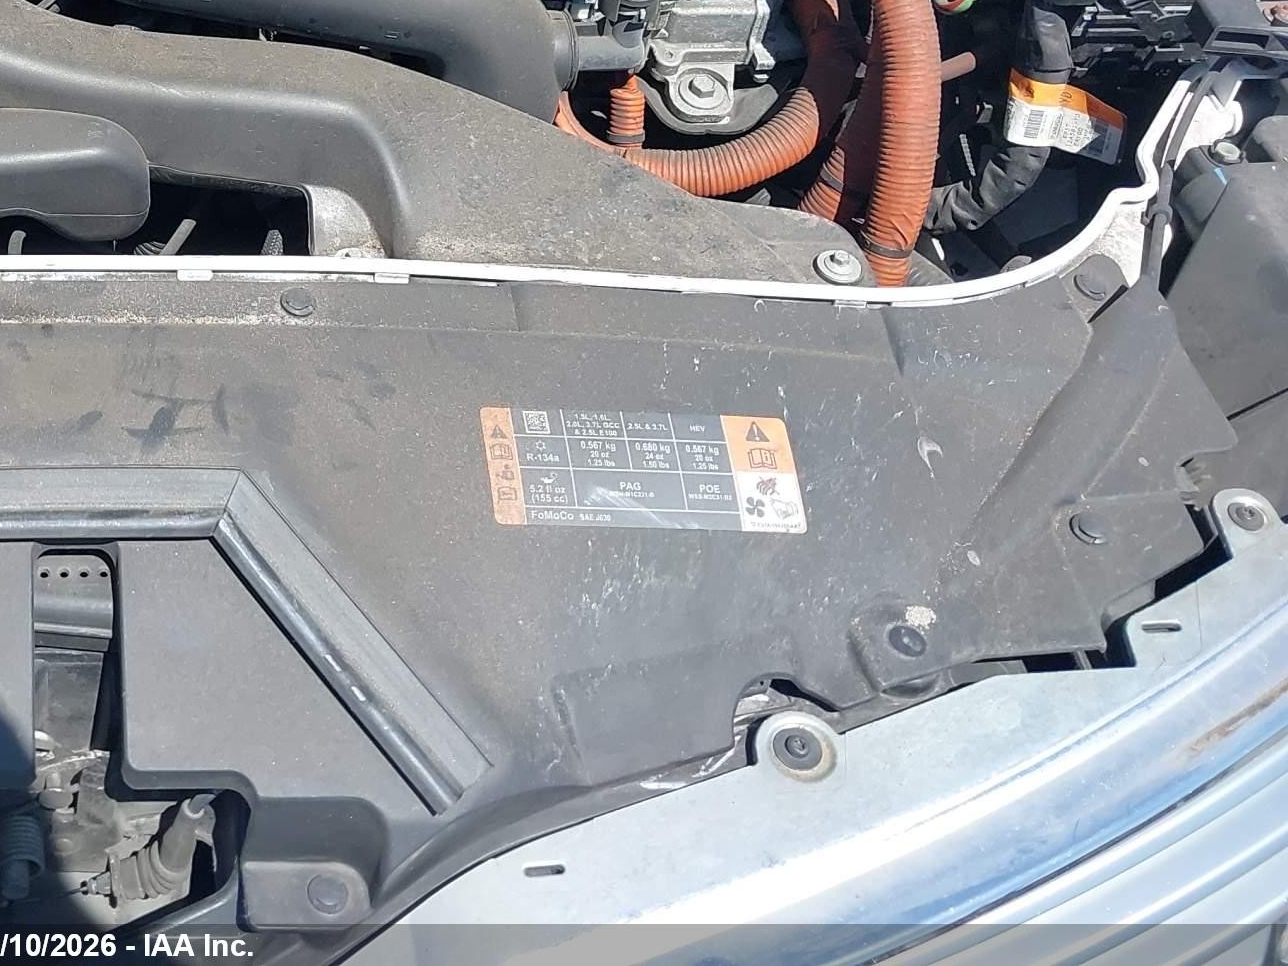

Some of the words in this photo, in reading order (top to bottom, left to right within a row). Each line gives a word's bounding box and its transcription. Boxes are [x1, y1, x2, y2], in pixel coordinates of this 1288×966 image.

[690, 424, 706, 432] HEV
[580, 440, 602, 450] 0.567
[605, 440, 616, 452] kg
[660, 442, 671, 454] kg
[619, 482, 642, 491] PAG
[699, 484, 721, 494] POE
[531, 510, 574, 520] FoMoCo
